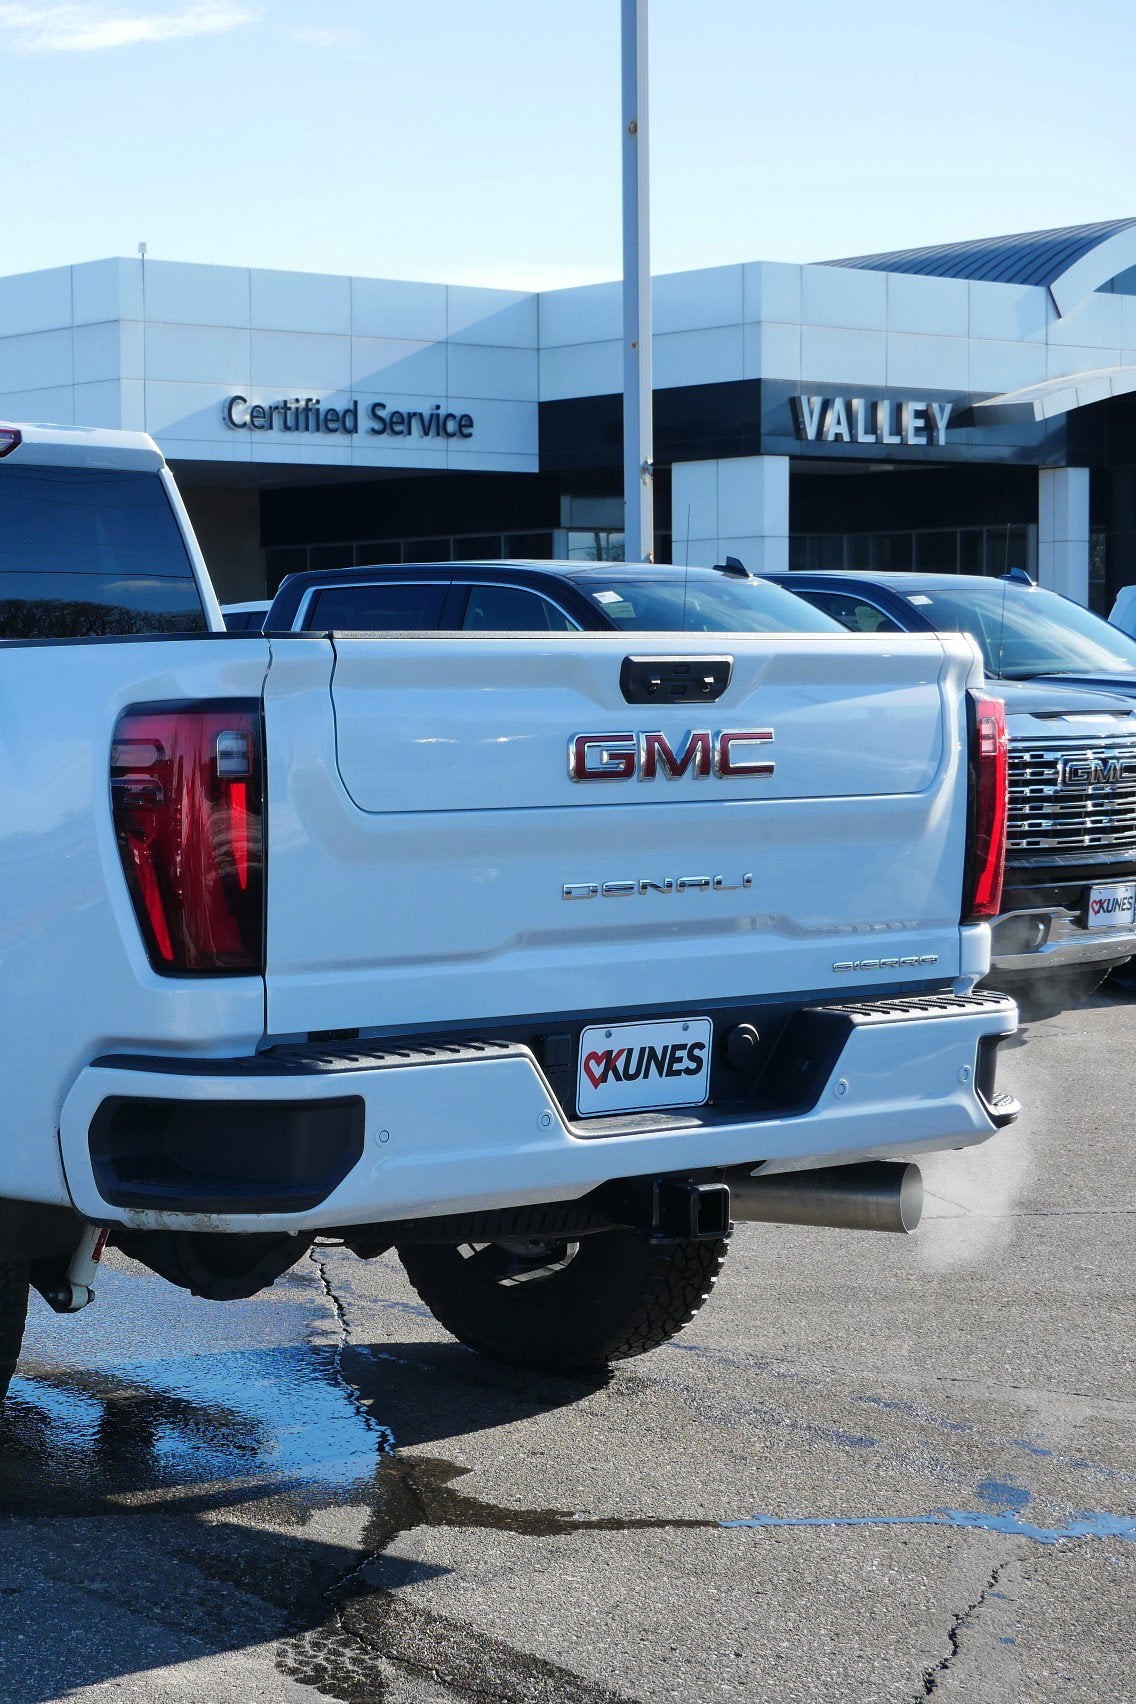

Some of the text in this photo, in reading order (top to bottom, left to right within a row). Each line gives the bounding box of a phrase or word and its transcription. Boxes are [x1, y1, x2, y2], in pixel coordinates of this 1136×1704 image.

[224, 394, 475, 438] Certified Service
[790, 395, 953, 446] VALLEY
[567, 728, 775, 783] GMC
[562, 873, 753, 901] DENALI
[1097, 896, 1133, 913] KUNES
[832, 954, 938, 973] SIERRA
[599, 1041, 706, 1083] KUNES
